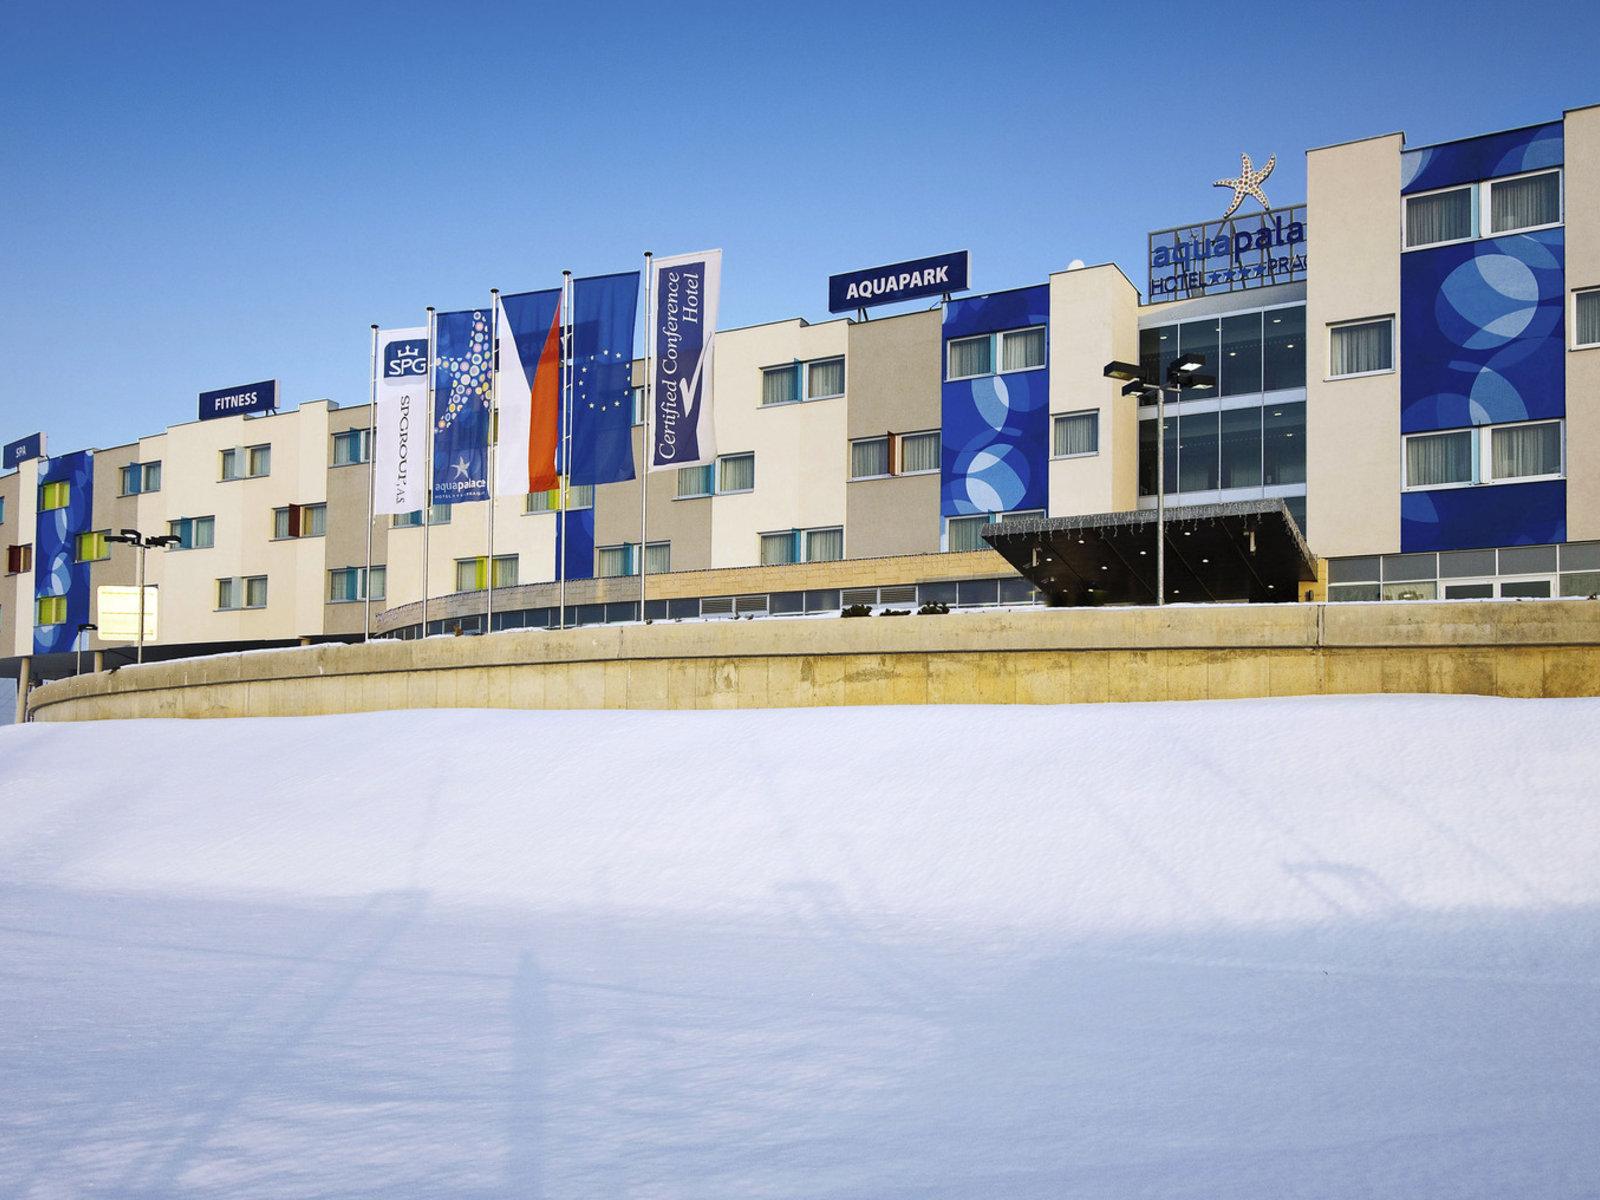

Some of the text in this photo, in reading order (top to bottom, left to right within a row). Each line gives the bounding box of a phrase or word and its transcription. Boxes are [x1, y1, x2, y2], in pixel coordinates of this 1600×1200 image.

[846, 265, 949, 300] AQUAPARK
[1151, 271, 1207, 295] HOTEL
[682, 273, 699, 324] Hotel
[389, 357, 427, 375] SPG
[659, 272, 682, 459] Certified Conference
[214, 391, 258, 411] FITNESS
